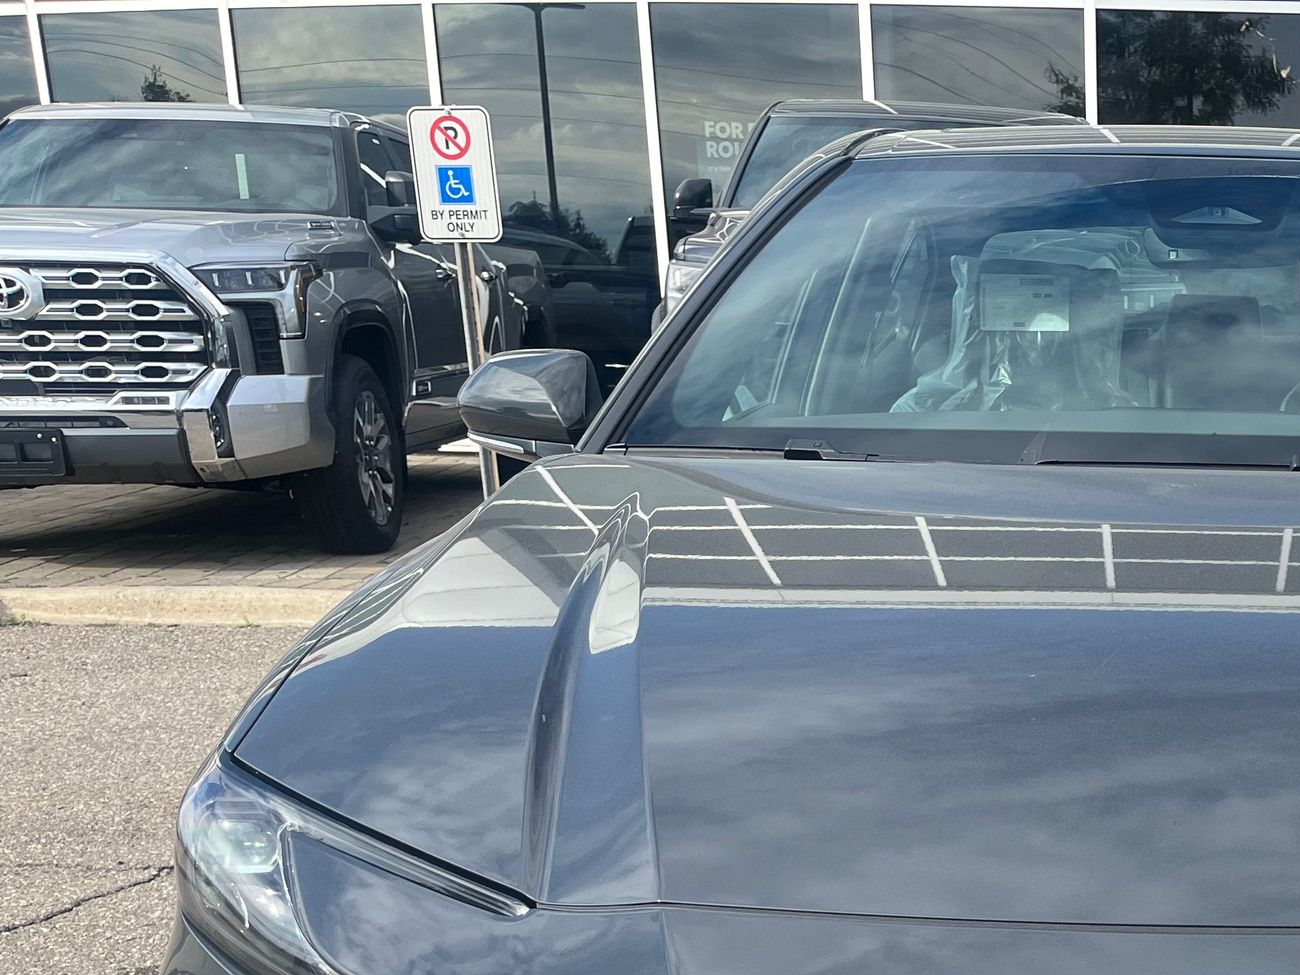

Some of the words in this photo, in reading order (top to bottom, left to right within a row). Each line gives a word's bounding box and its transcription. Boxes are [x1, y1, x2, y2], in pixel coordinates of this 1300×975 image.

[704, 121, 744, 139] FOR
[431, 209, 445, 220] BY
[448, 209, 488, 221] PERMIT
[447, 222, 475, 233] ONLY
